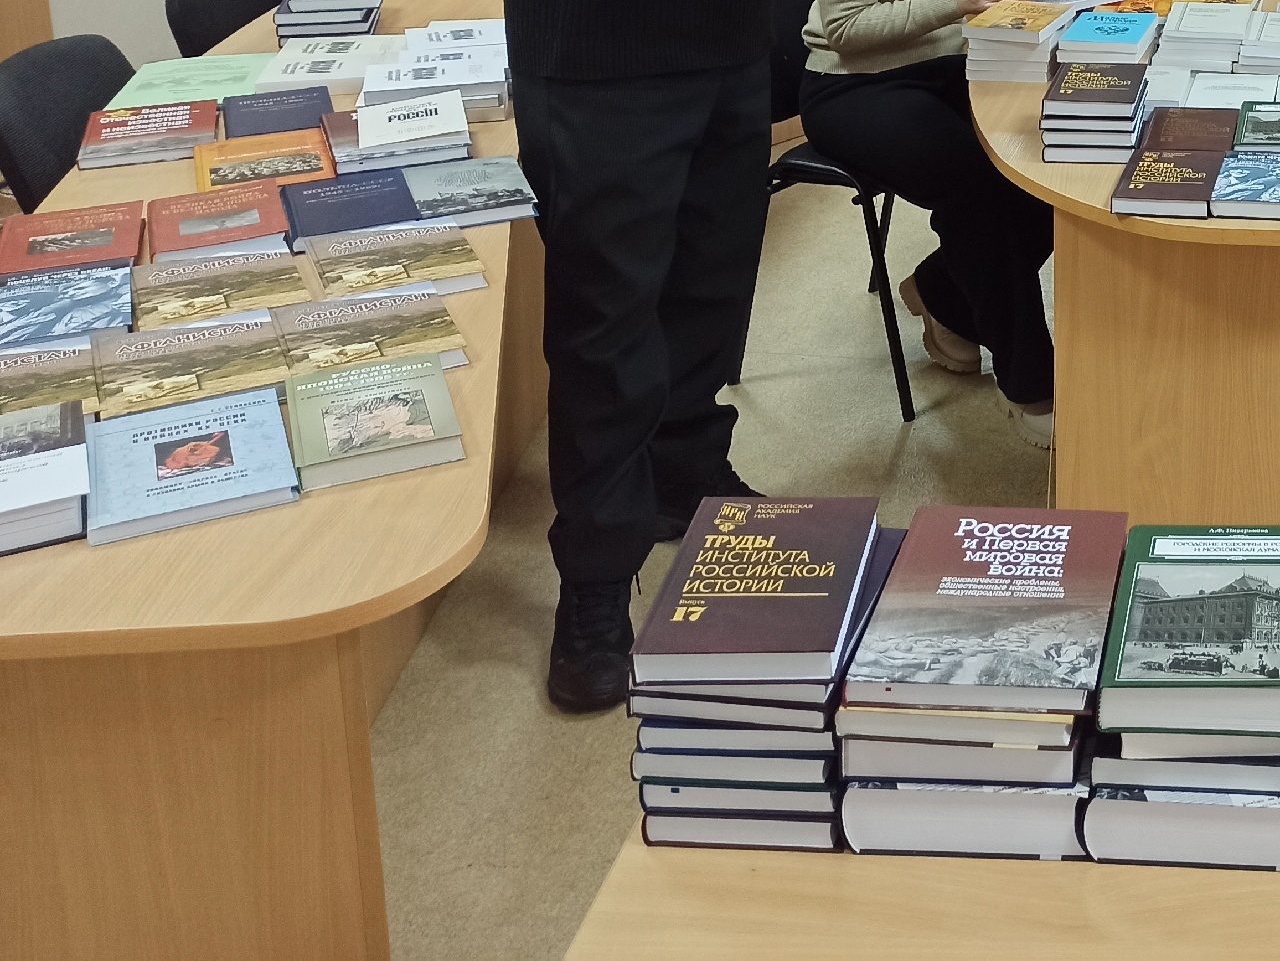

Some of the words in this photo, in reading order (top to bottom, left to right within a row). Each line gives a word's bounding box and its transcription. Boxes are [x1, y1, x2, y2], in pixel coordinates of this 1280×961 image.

[328, 226, 451, 251] АФГАНИСТАН
[148, 252, 281, 280] АФГАНИСТАН
[295, 293, 430, 324] АФГАНИСТАН
[116, 322, 262, 354] АФГАНИСТАН
[954, 518, 1072, 540] Россия
[704, 535, 777, 550] ТРУДЫ
[961, 538, 980, 549] и
[982, 536, 1069, 553] Первая
[695, 550, 810, 563] ИНСТИТУТА
[963, 550, 1066, 565] мировая
[689, 560, 836, 577] РОССИЙСКОЙ
[682, 579, 785, 592] ИСТОРИИ
[939, 582, 1008, 591] общественные
[940, 576, 1012, 584] экономические
[936, 589, 1011, 597] международные
[669, 606, 709, 622] 17
